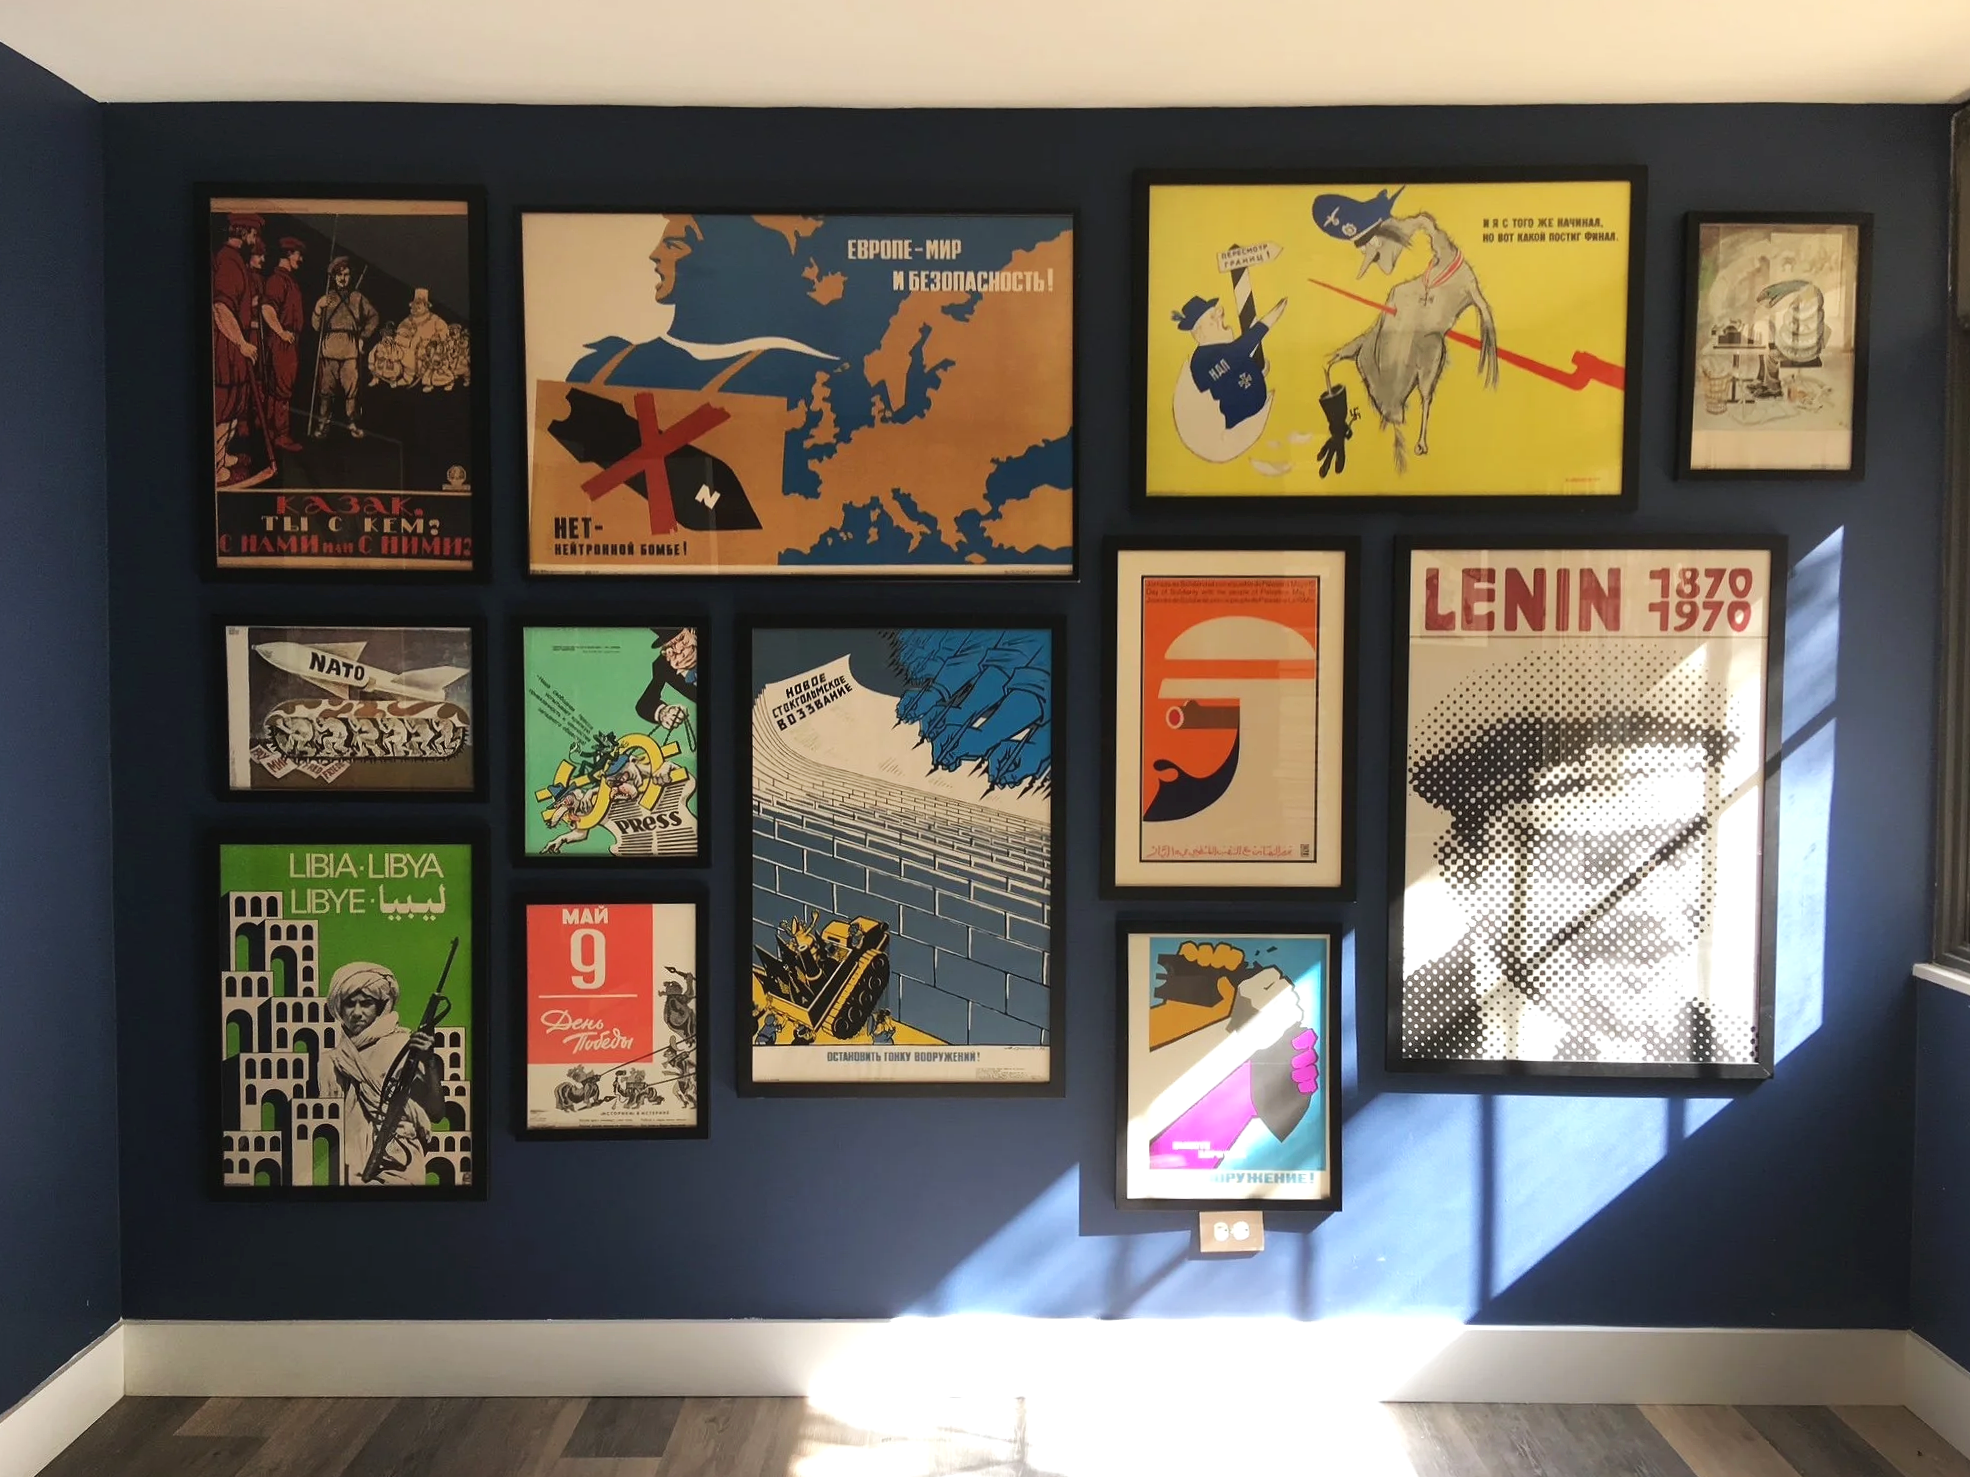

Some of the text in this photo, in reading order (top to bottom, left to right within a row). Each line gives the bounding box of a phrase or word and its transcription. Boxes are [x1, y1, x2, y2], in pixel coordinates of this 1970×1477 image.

[892, 268, 1053, 292] И БЕЗОПАСНОСТЬ!
[261, 516, 440, 536] ТЫ С КЕМ?
[219, 534, 232, 553] С
[241, 534, 319, 554] НАМИ
[358, 534, 373, 555] С
[555, 541, 687, 556] НЕЙТРОННОЙ БОМБЕ!
[1648, 567, 1753, 599] 1870
[1424, 567, 1621, 632] LENIN
[1648, 600, 1752, 632] 1970
[309, 652, 365, 680] NATO
[771, 675, 847, 718] СТОКГОЛЬМСКОЕ
[785, 672, 827, 698] НОВОЕ
[776, 683, 853, 731] ВОЗЗВАНИЕ
[291, 888, 365, 914] LIBYE
[379, 883, 446, 921] ليبيا
[562, 905, 609, 925] МАЙ
[570, 928, 606, 990] 9
[540, 1009, 604, 1034] День
[562, 1028, 634, 1054] Победы
[826, 1051, 881, 1062] ОСТАНОВИТЬ
[884, 1051, 911, 1062] ГОНКУ
[1209, 1172, 1314, 1184] ОРУЖЕНИЕ!
